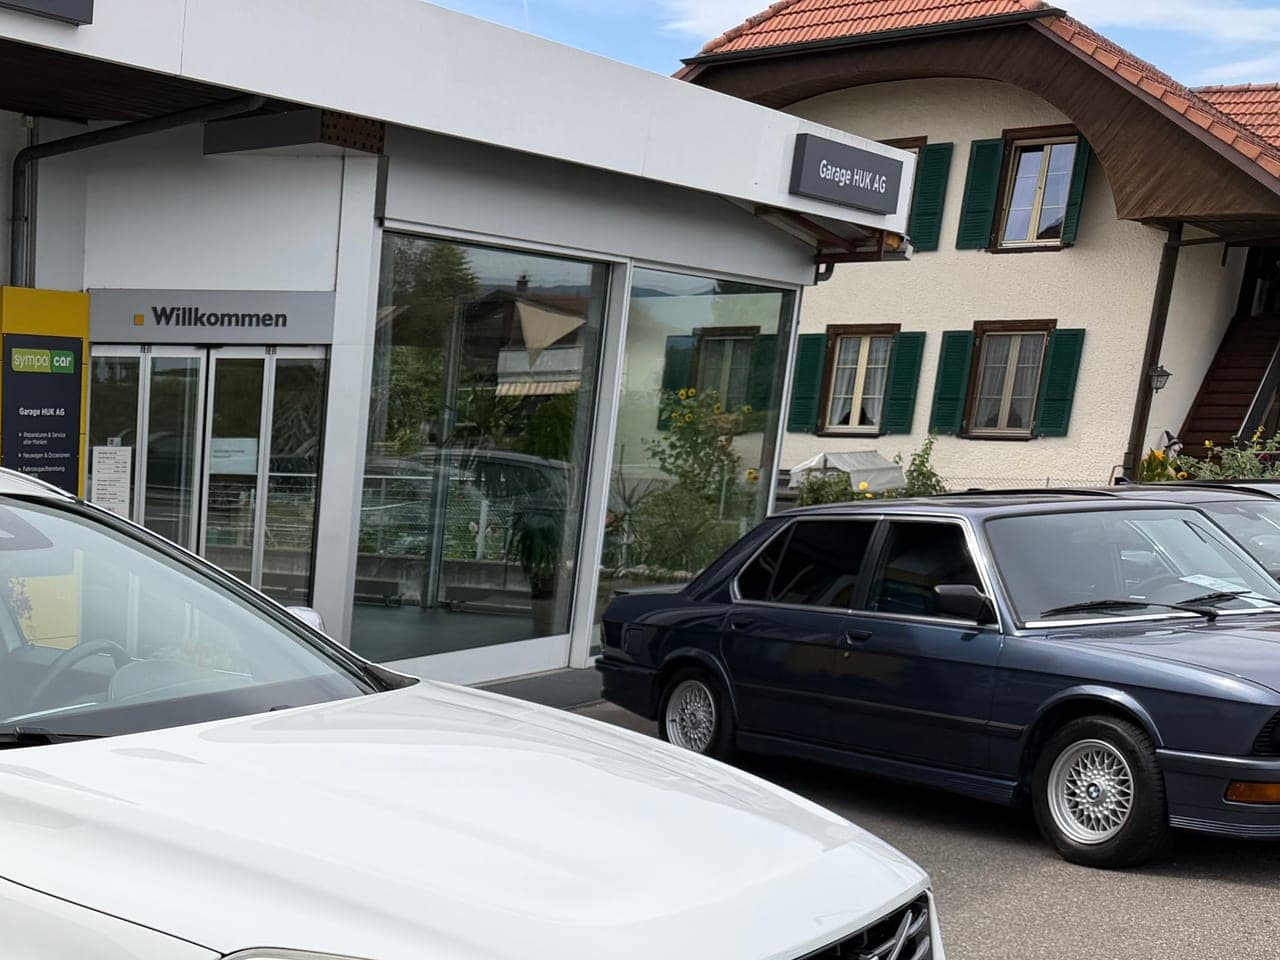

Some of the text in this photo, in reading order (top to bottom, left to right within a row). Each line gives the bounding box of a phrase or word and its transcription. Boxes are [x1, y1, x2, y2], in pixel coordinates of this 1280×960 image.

[820, 160, 887, 193] Garage HUK AG
[151, 306, 287, 327] Willkommen
[14, 354, 72, 369] sympa car
[18, 407, 65, 417] Garage HUK AG
